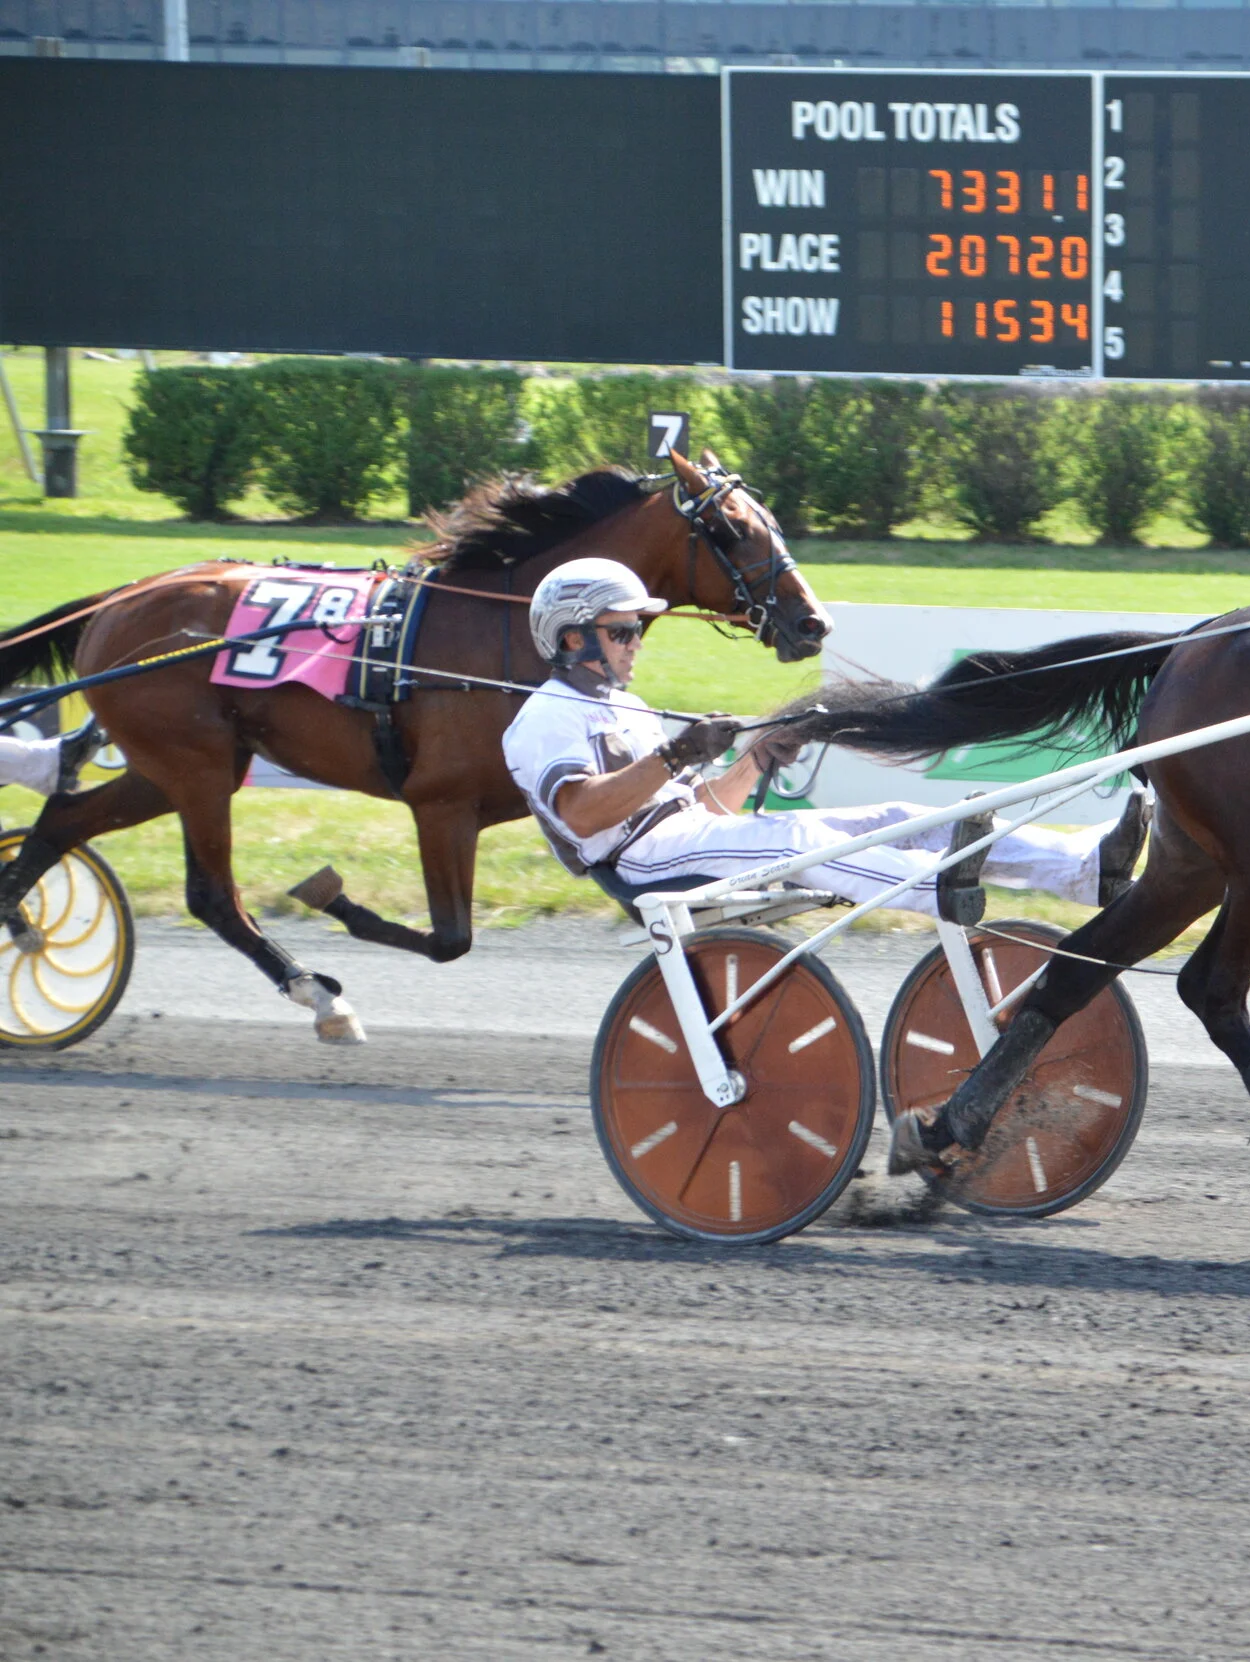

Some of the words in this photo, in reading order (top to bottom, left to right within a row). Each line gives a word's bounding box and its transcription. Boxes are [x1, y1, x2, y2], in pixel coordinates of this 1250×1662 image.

[792, 101, 885, 141] POOL
[888, 102, 1020, 143] TOTALS
[1106, 100, 1123, 132] 1
[752, 168, 826, 208] WIN
[929, 169, 1088, 214] 73311
[1105, 156, 1125, 190] 2
[1105, 213, 1125, 247] 3
[740, 232, 840, 273] PLACE
[926, 233, 1088, 280] 20720
[1104, 270, 1124, 302] 4
[742, 296, 840, 336] SHOW
[941, 299, 1088, 343] 11534
[1104, 327, 1124, 360] 5
[651, 414, 683, 457] 7
[227, 579, 320, 679] 7
[312, 586, 358, 624] 8
[649, 919, 674, 956] S
